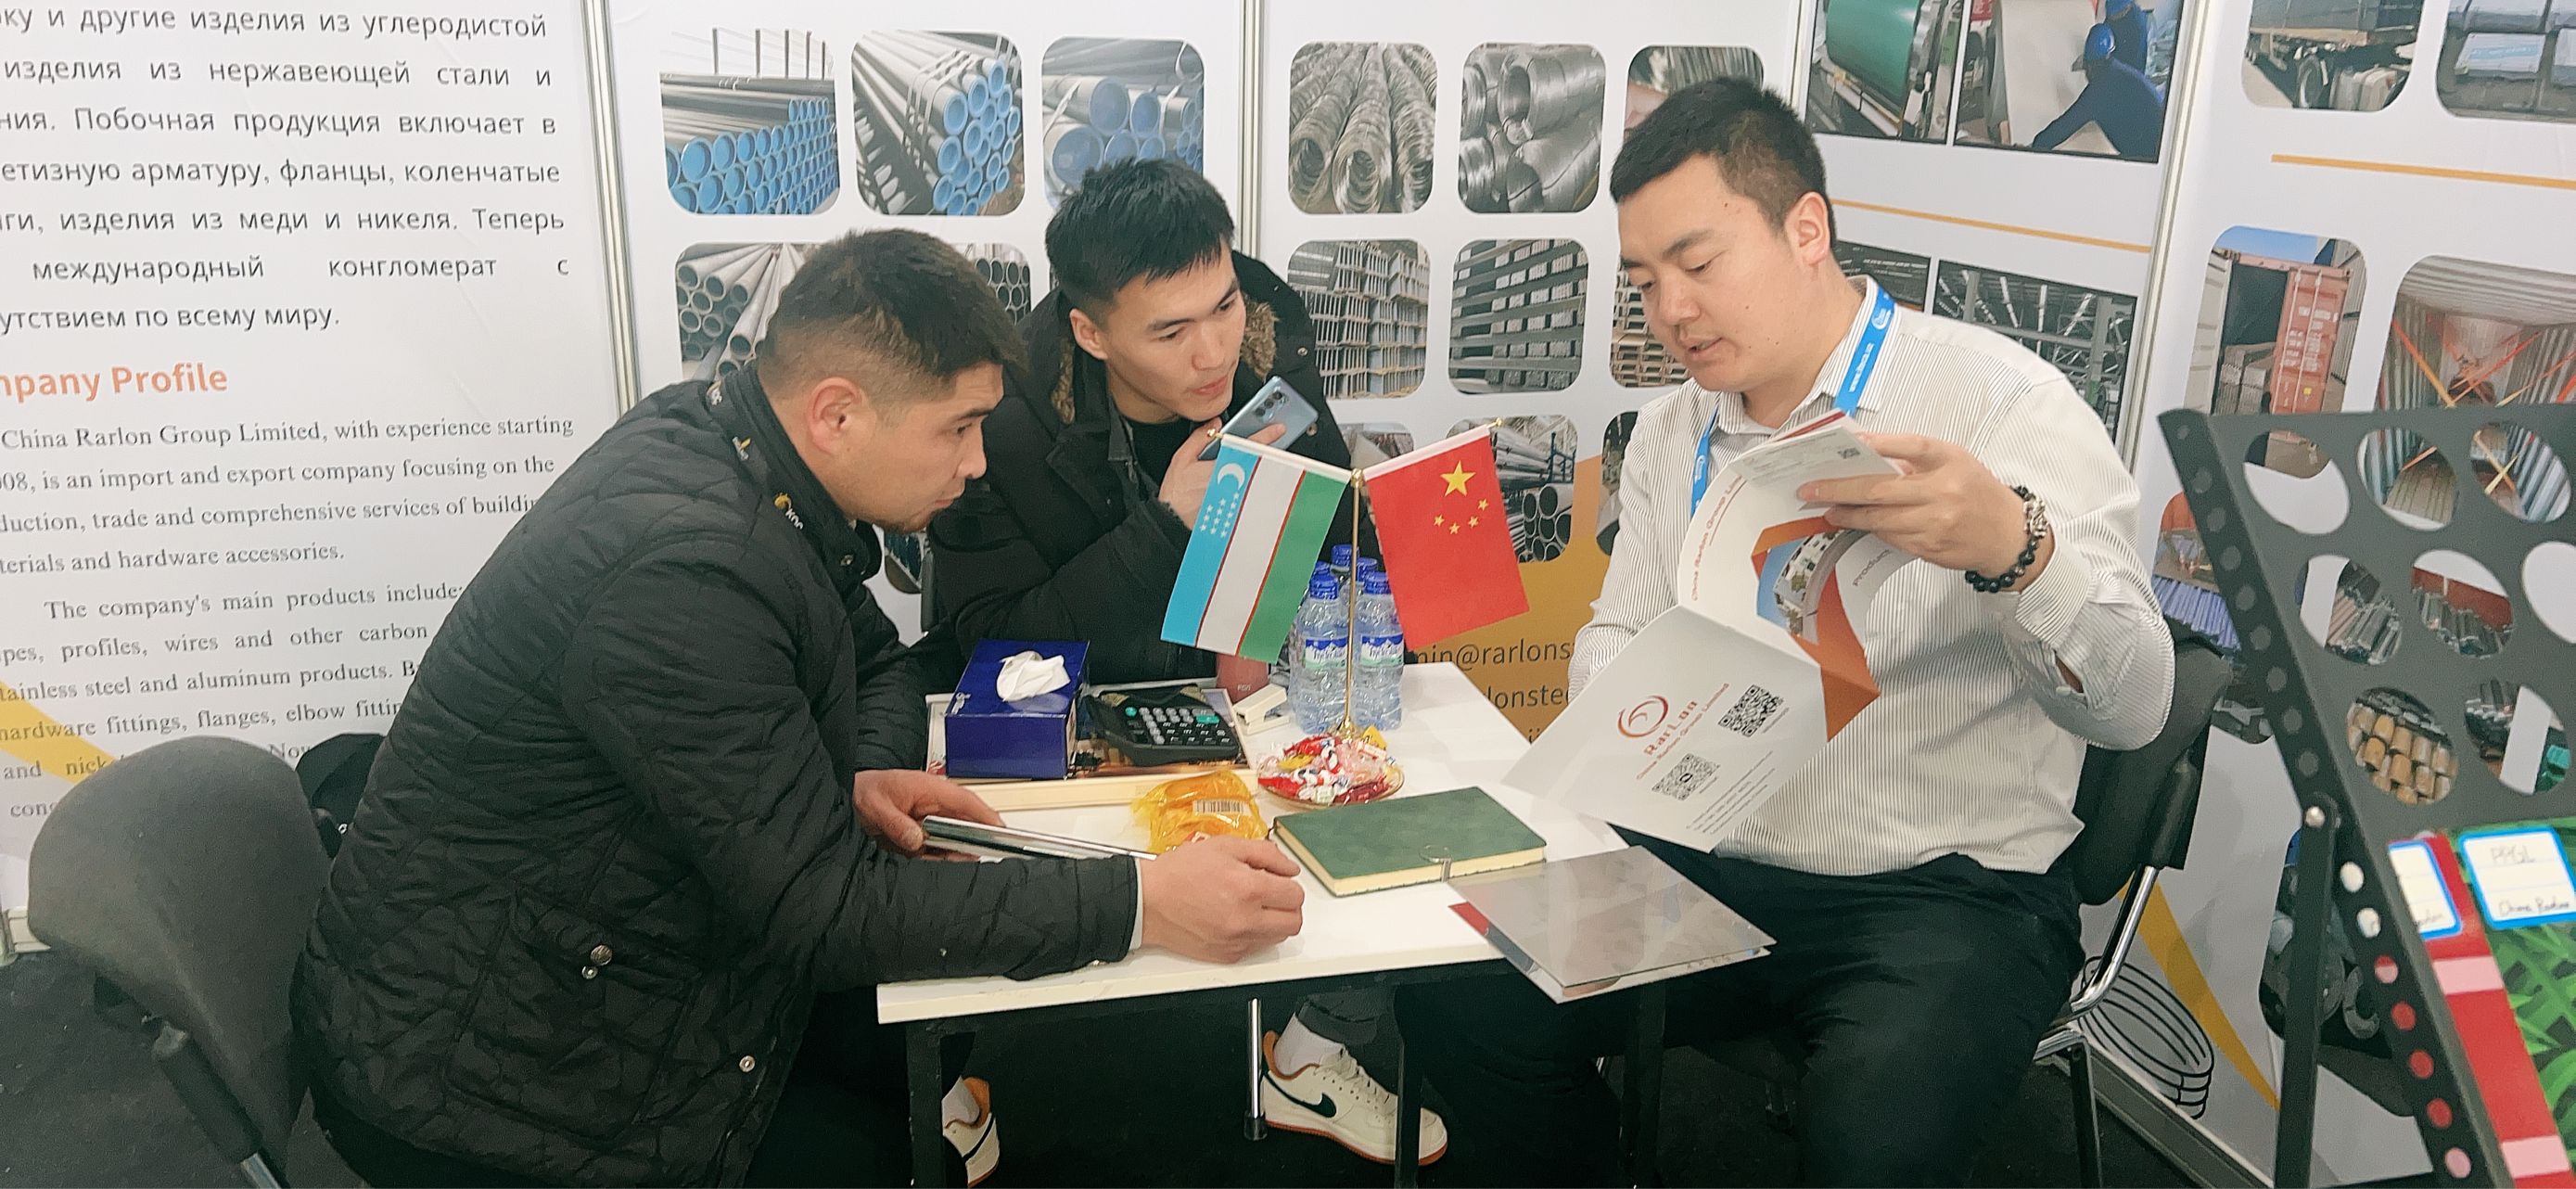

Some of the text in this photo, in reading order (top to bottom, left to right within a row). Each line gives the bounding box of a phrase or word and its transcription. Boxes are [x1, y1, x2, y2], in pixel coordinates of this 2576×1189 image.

[0, 8, 546, 41] ку и другие изделия из углеродистой
[5, 60, 551, 89] изделия из нержавеющей стали и
[75, 107, 214, 131] Побочная
[234, 114, 379, 138] продукция
[399, 116, 524, 134] включает
[542, 118, 555, 134] в
[2, 159, 559, 187] етизную арматуру, фланцы, коленчатые
[0, 209, 564, 236] ги, изделия из меди и никеля. Теперь
[32, 255, 568, 286] международный конгломерат с
[135, 310, 168, 326] по
[177, 309, 255, 332] всему
[265, 308, 338, 331] миру.
[112, 363, 227, 393] Profile
[1, 416, 574, 449] China Rarlon Group Limited, with experience starting
[0, 454, 555, 493] 08, is an import and export company focusing on the
[93, 508, 148, 529] trade
[155, 506, 195, 527] and
[201, 501, 356, 527] comprehensive
[363, 498, 440, 518] services
[446, 496, 467, 515] of
[71, 551, 111, 571] and
[118, 549, 222, 569] hardware
[225, 542, 344, 564] accessories.
[44, 582, 463, 620] The company's main products include
[0, 623, 427, 667] pes, profiles, wires and other carbon
[1417, 637, 1574, 671] in@rarlons
[85, 676, 131, 697] steel
[140, 673, 178, 693] and
[186, 669, 290, 690] aluminum
[300, 663, 393, 687] products.
[1484, 684, 1569, 710] lonste
[107, 714, 187, 735] fittings,
[198, 710, 275, 729] flanges,
[287, 704, 345, 722] elbow
[4, 761, 42, 779] and
